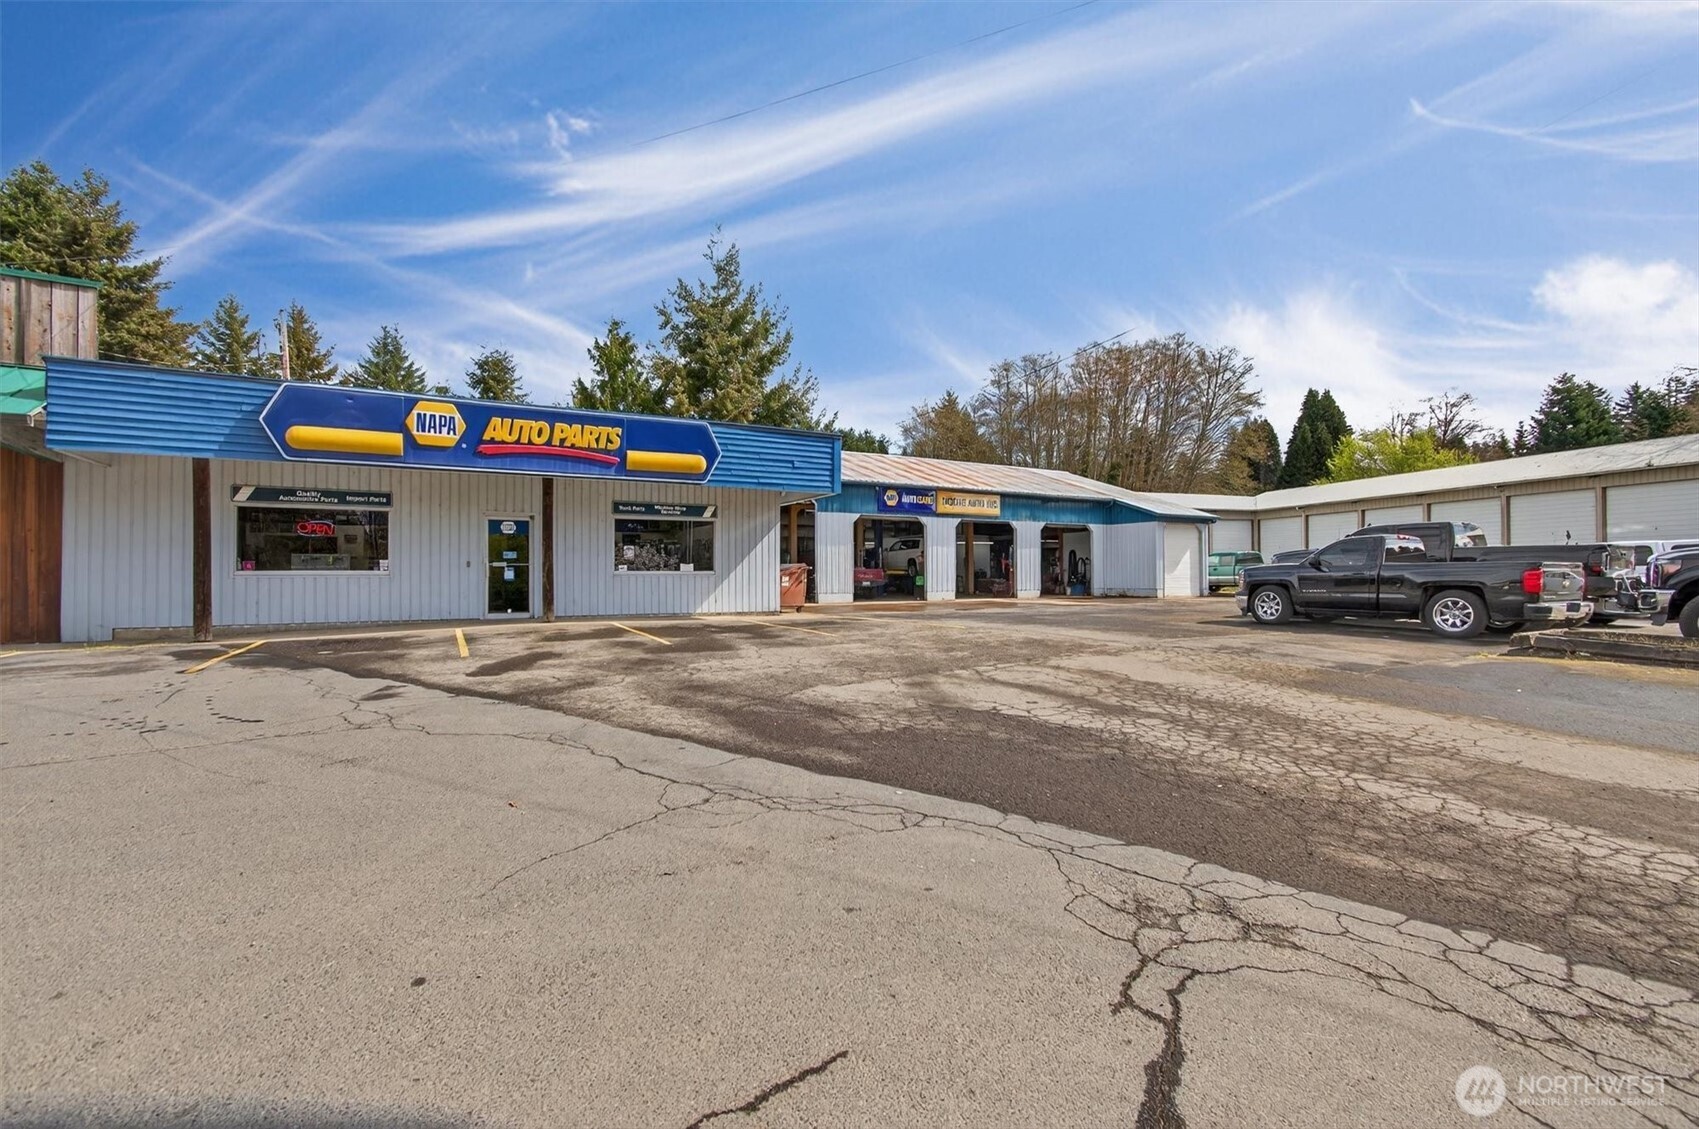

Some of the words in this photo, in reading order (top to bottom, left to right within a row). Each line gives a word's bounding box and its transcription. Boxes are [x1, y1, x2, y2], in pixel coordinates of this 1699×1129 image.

[415, 412, 457, 436] NAPA
[482, 416, 550, 445] AUTO
[552, 422, 622, 450] PARTS
[297, 521, 333, 535] OPEN
